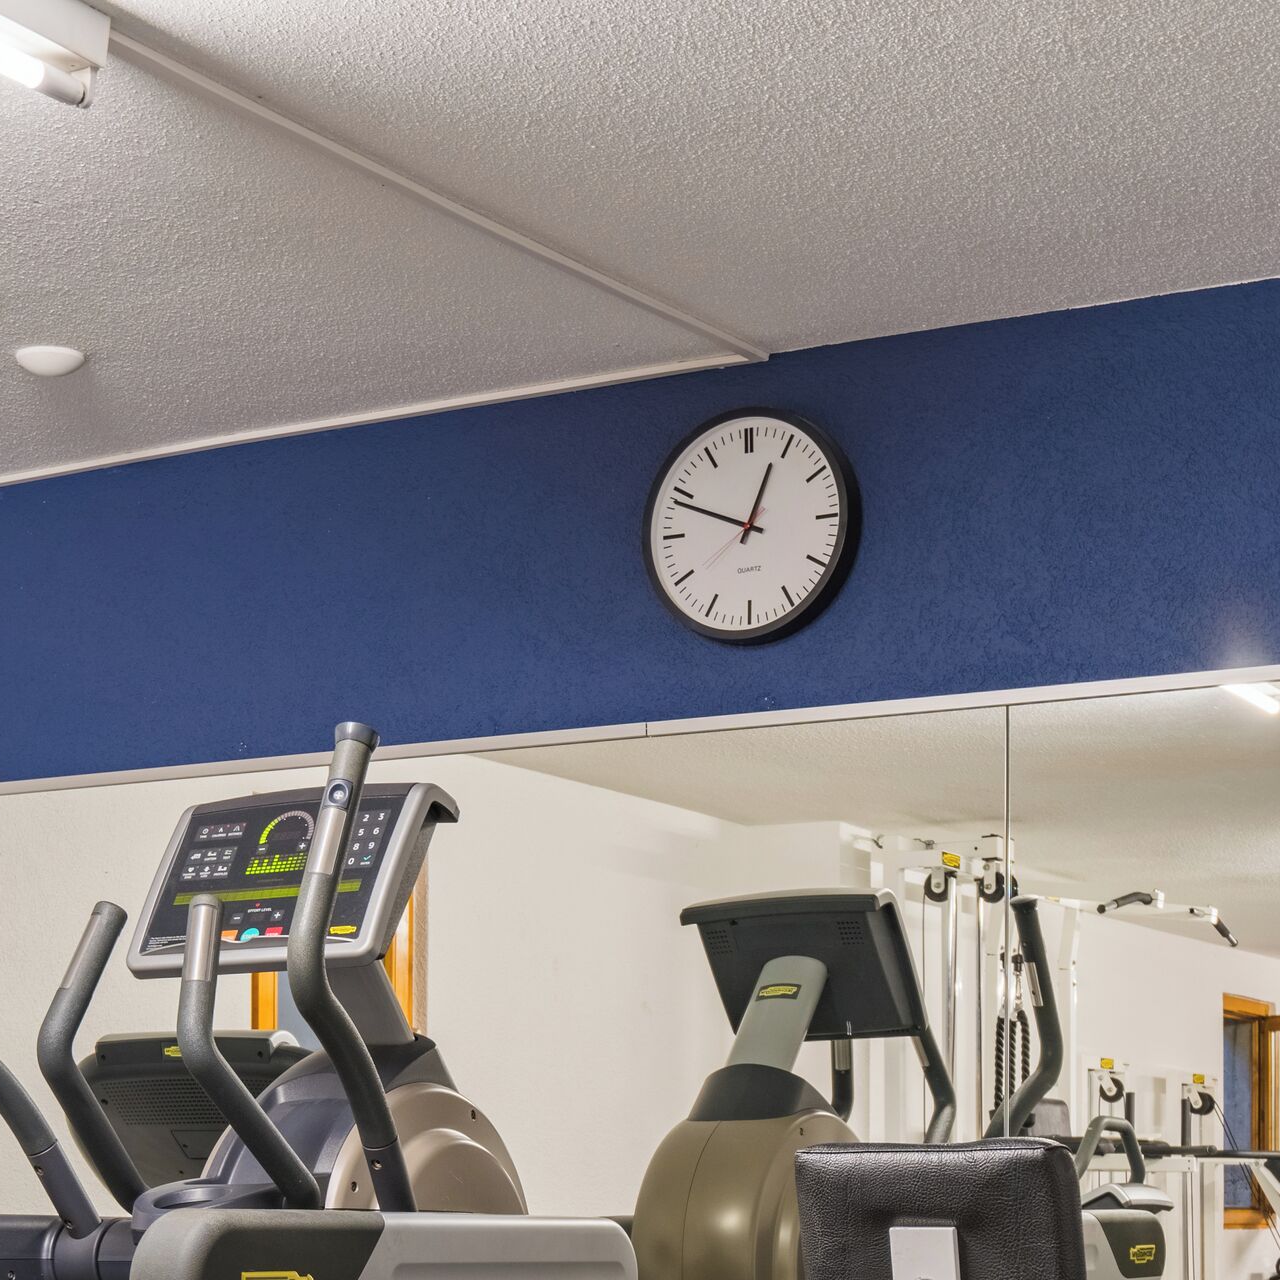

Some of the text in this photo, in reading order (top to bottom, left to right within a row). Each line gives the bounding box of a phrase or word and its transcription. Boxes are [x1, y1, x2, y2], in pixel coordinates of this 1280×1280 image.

[736, 565, 762, 574] QUARTZ
[362, 812, 385, 822] 2 3
[357, 827, 380, 836] 5 6
[352, 841, 375, 851] 8 9
[347, 857, 355, 865] 0
